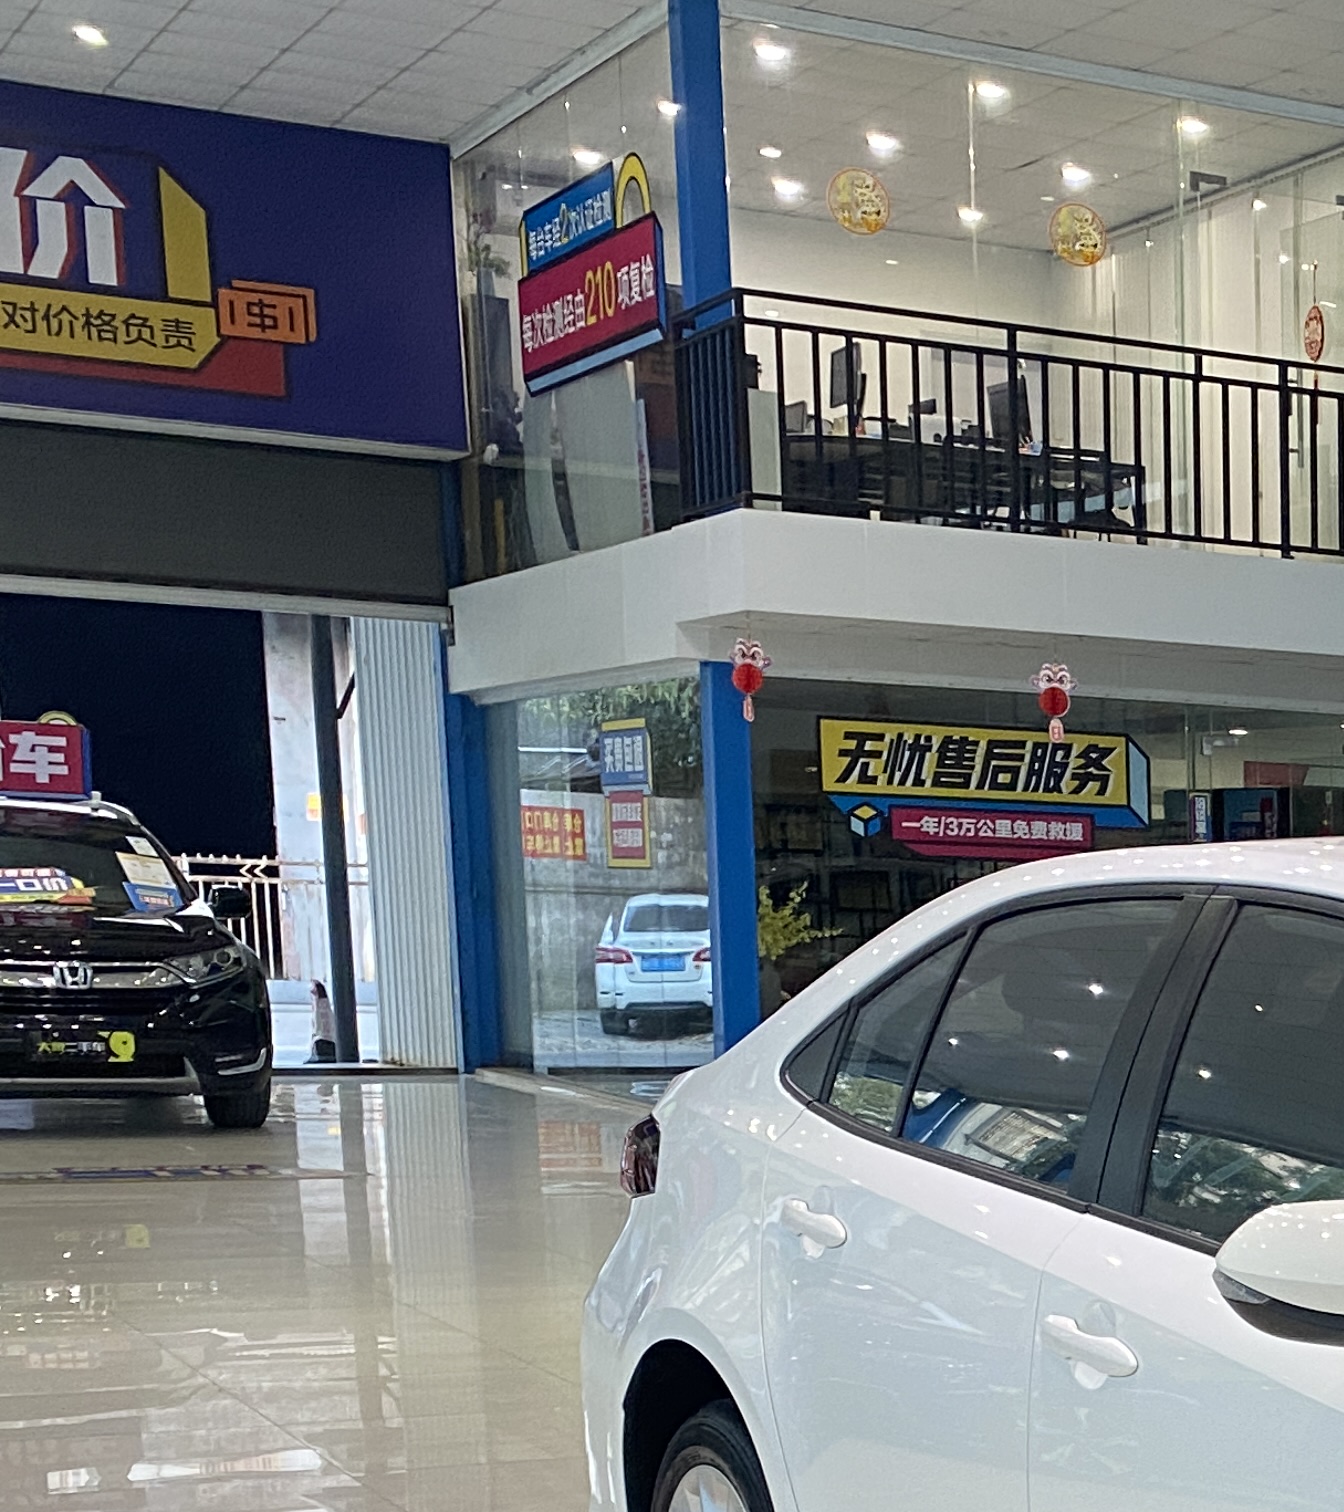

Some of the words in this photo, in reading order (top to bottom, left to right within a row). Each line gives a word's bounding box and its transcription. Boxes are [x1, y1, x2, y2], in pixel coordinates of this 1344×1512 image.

[835, 730, 1121, 797] 无忧售后服务
